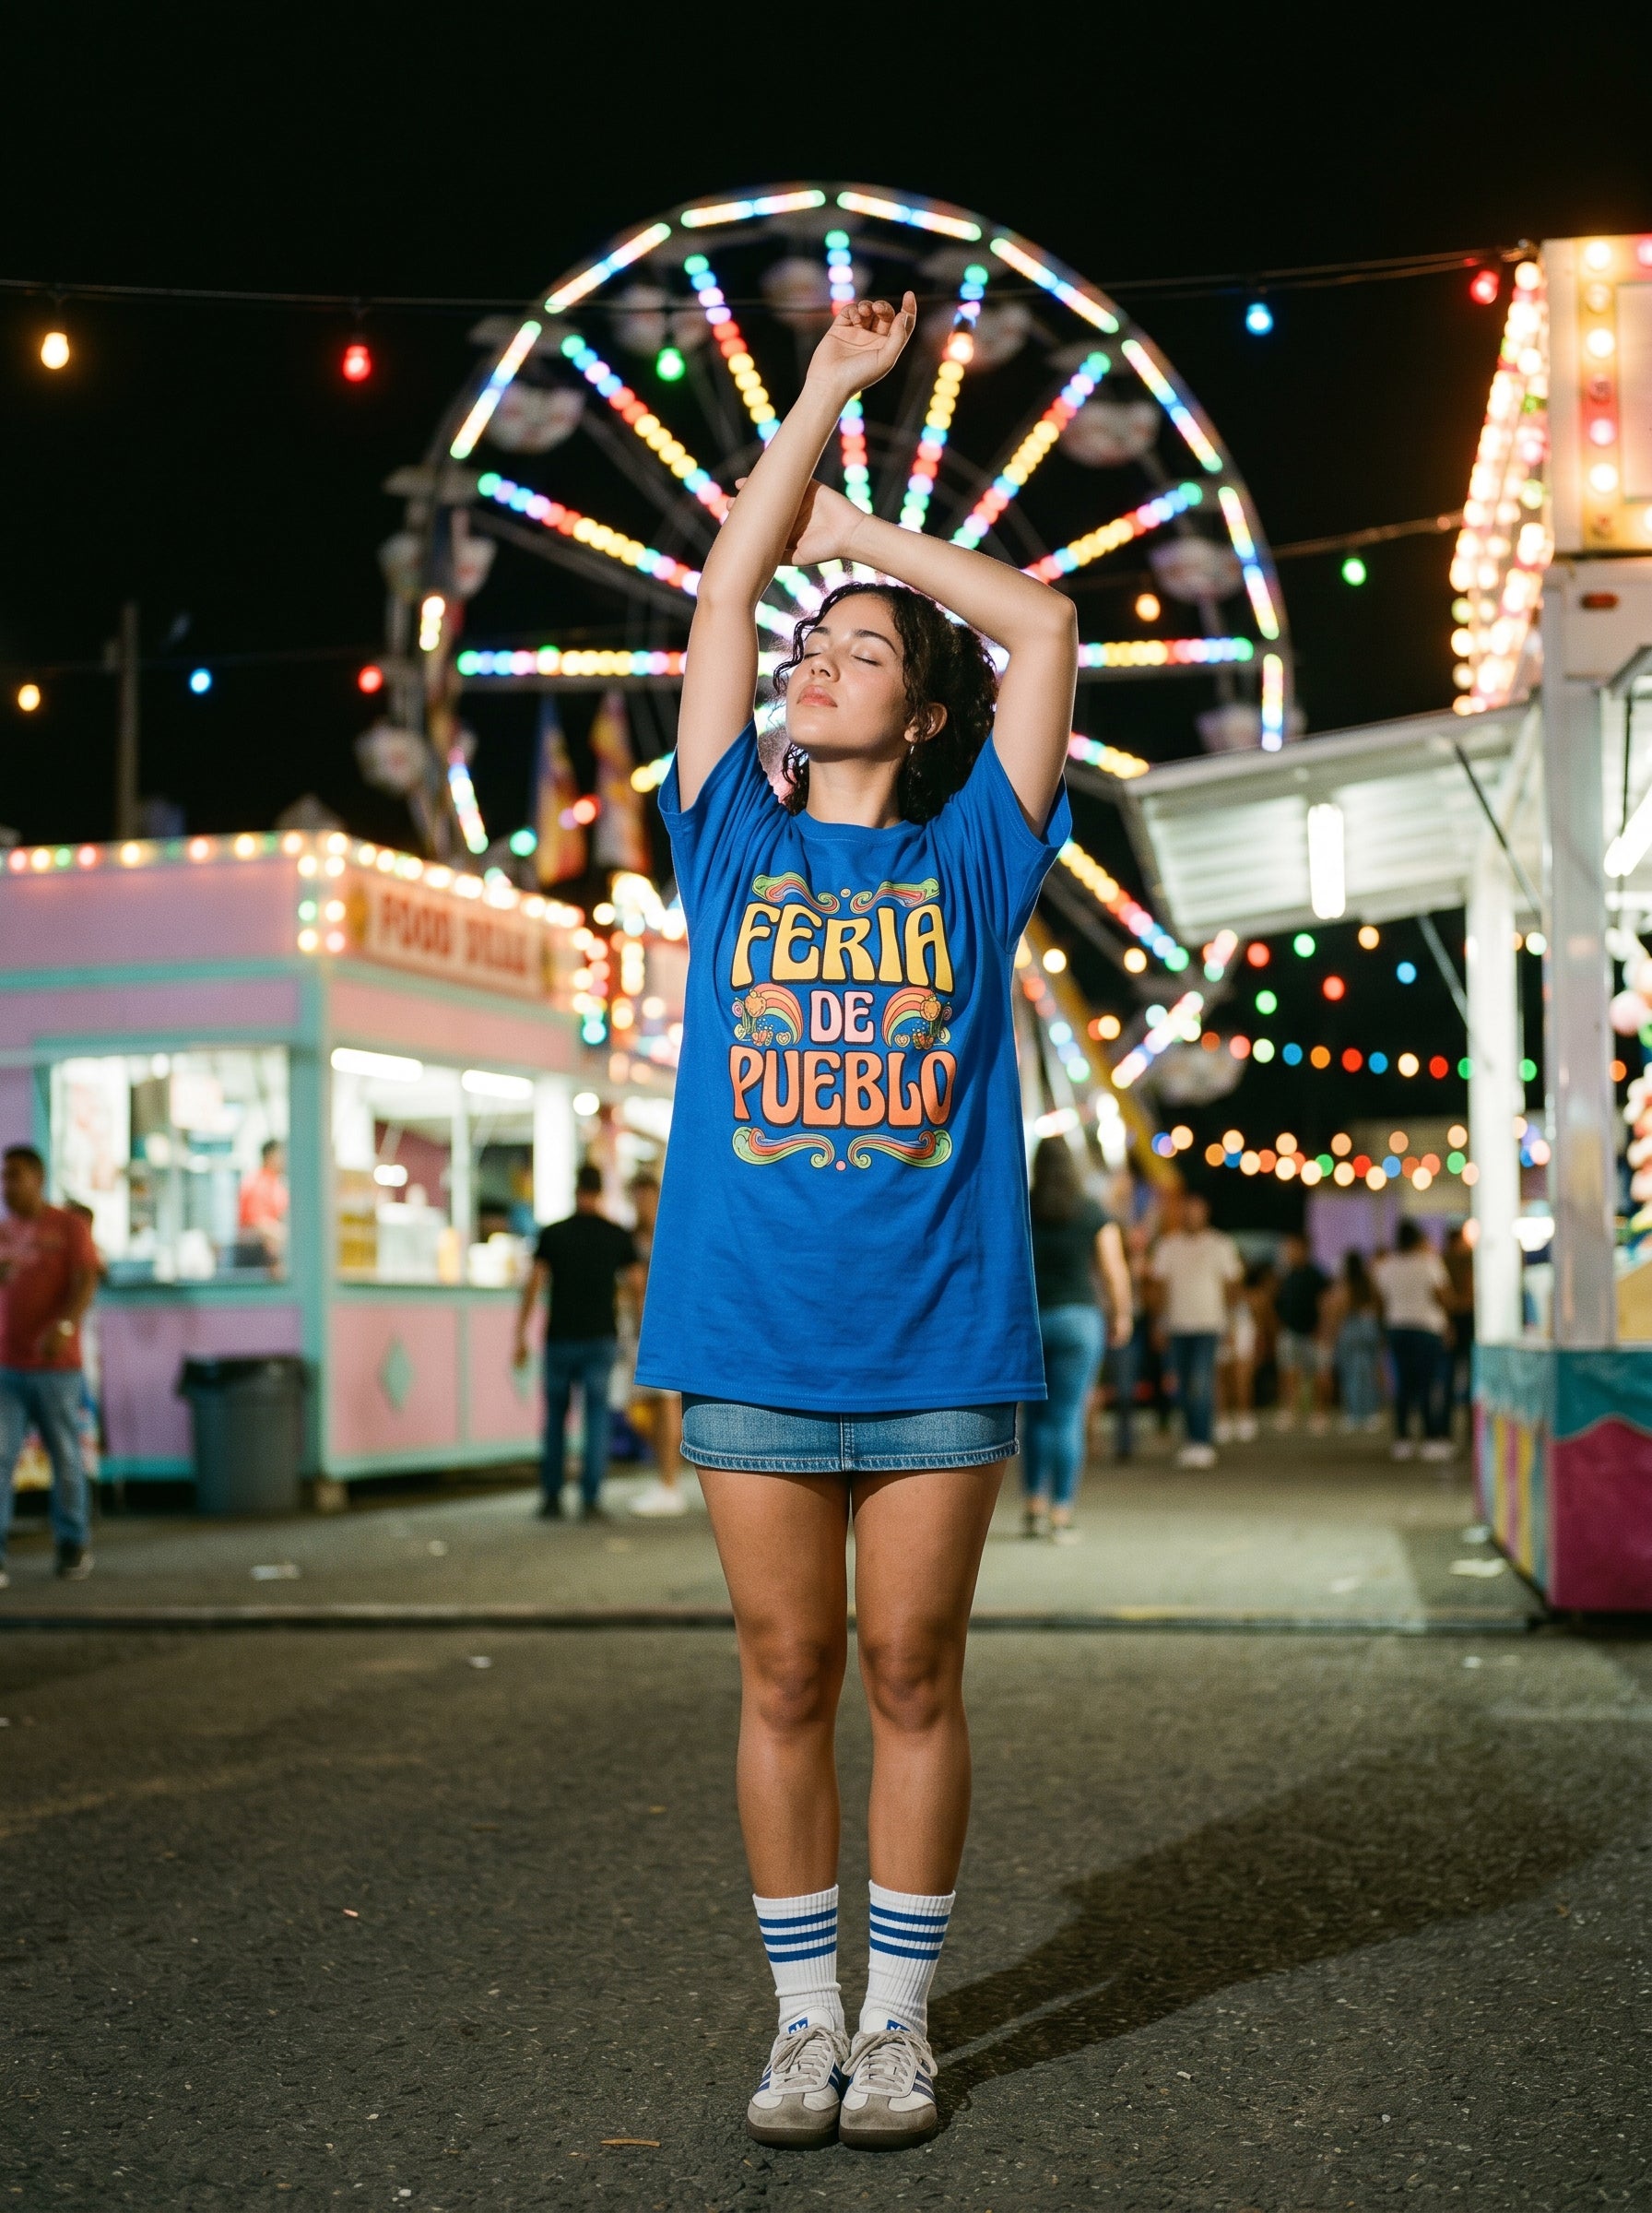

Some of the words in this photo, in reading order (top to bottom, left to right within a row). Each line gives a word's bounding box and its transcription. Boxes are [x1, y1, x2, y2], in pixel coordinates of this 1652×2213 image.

[730, 901, 955, 995] FERIA
[809, 989, 875, 1045] DE
[729, 1044, 958, 1129] PUEBLO
